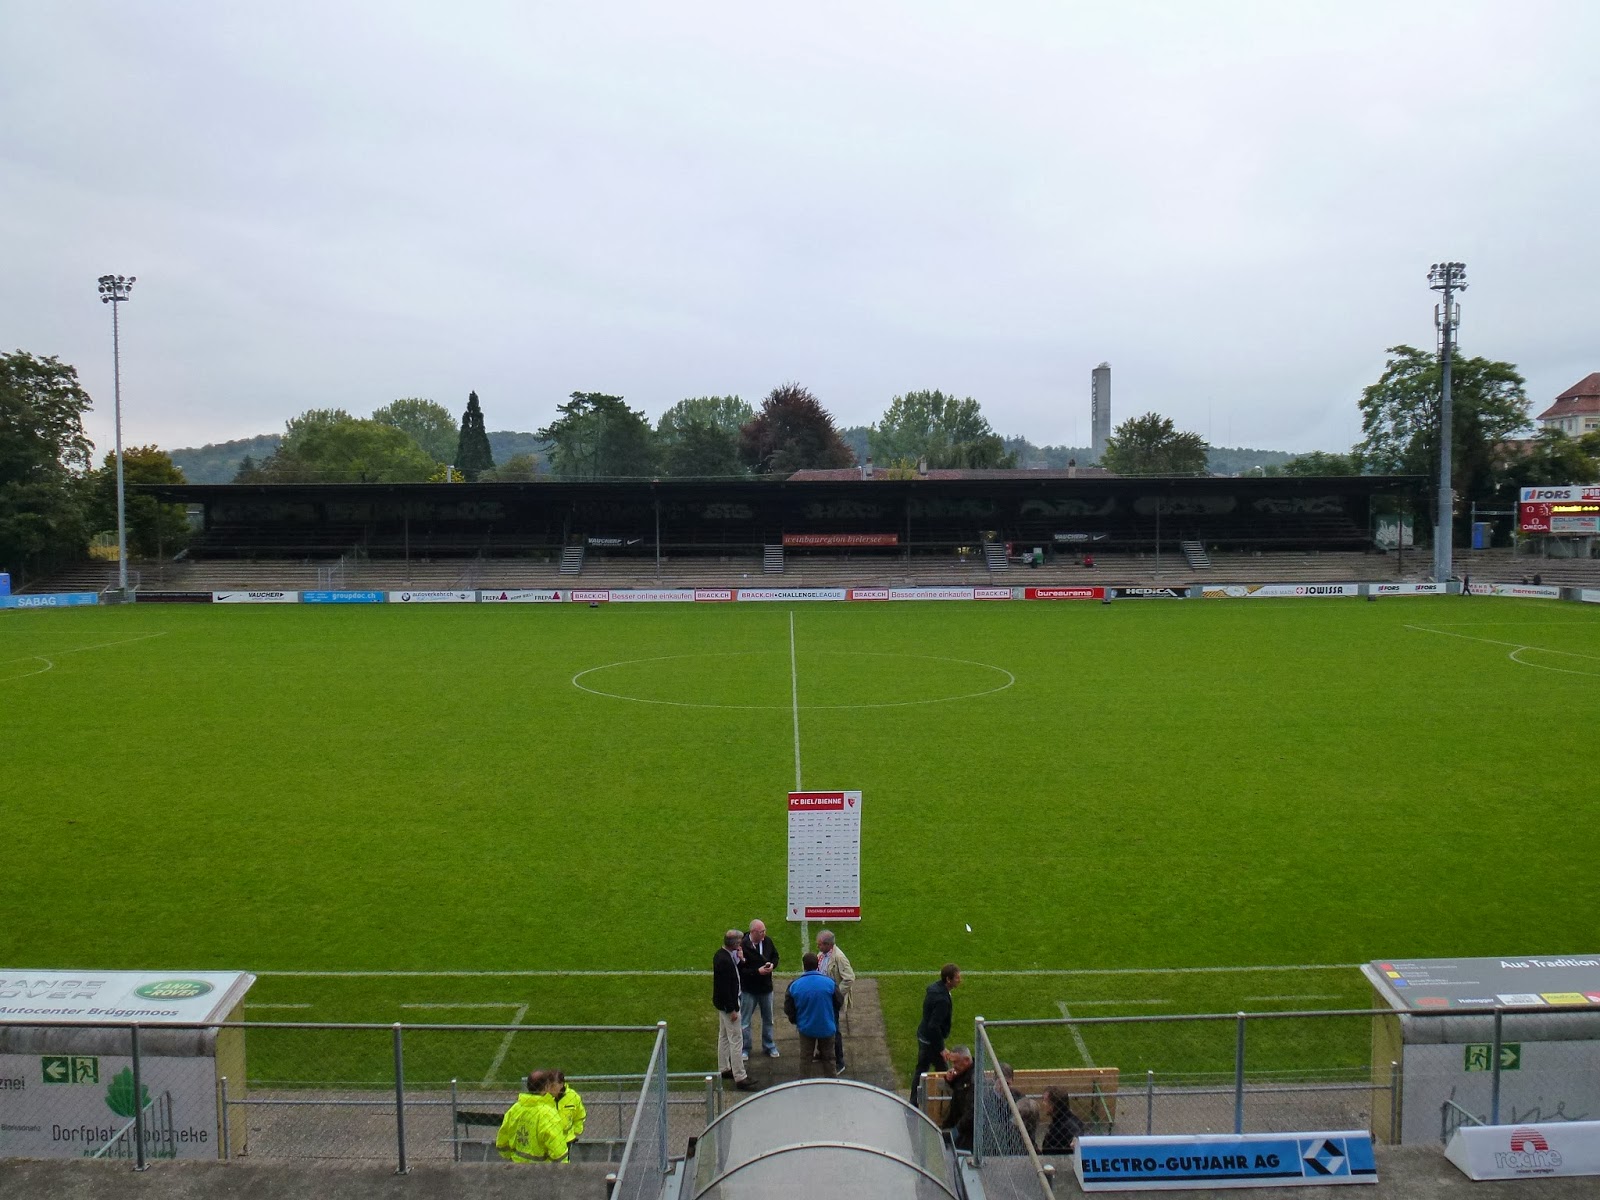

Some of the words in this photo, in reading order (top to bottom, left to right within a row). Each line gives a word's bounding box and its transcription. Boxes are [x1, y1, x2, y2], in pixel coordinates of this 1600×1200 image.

[1536, 490, 1571, 499] FORS
[785, 535, 845, 544] weinbauregion
[1304, 586, 1343, 594] JOWISSA
[332, 592, 376, 600] groupdoc.ch
[18, 597, 57, 606] SABAG
[1500, 960, 1530, 969] Aus
[1528, 958, 1599, 968] Tradition
[0, 1007, 86, 1015] Autocenter
[87, 1007, 180, 1018] Brüggmoos
[53, 1124, 127, 1145] Dorfplatz
[1494, 1147, 1563, 1169] racine
[1082, 1156, 1247, 1174] ELECTRO-GUTJAHR
[1254, 1155, 1280, 1169] AG
